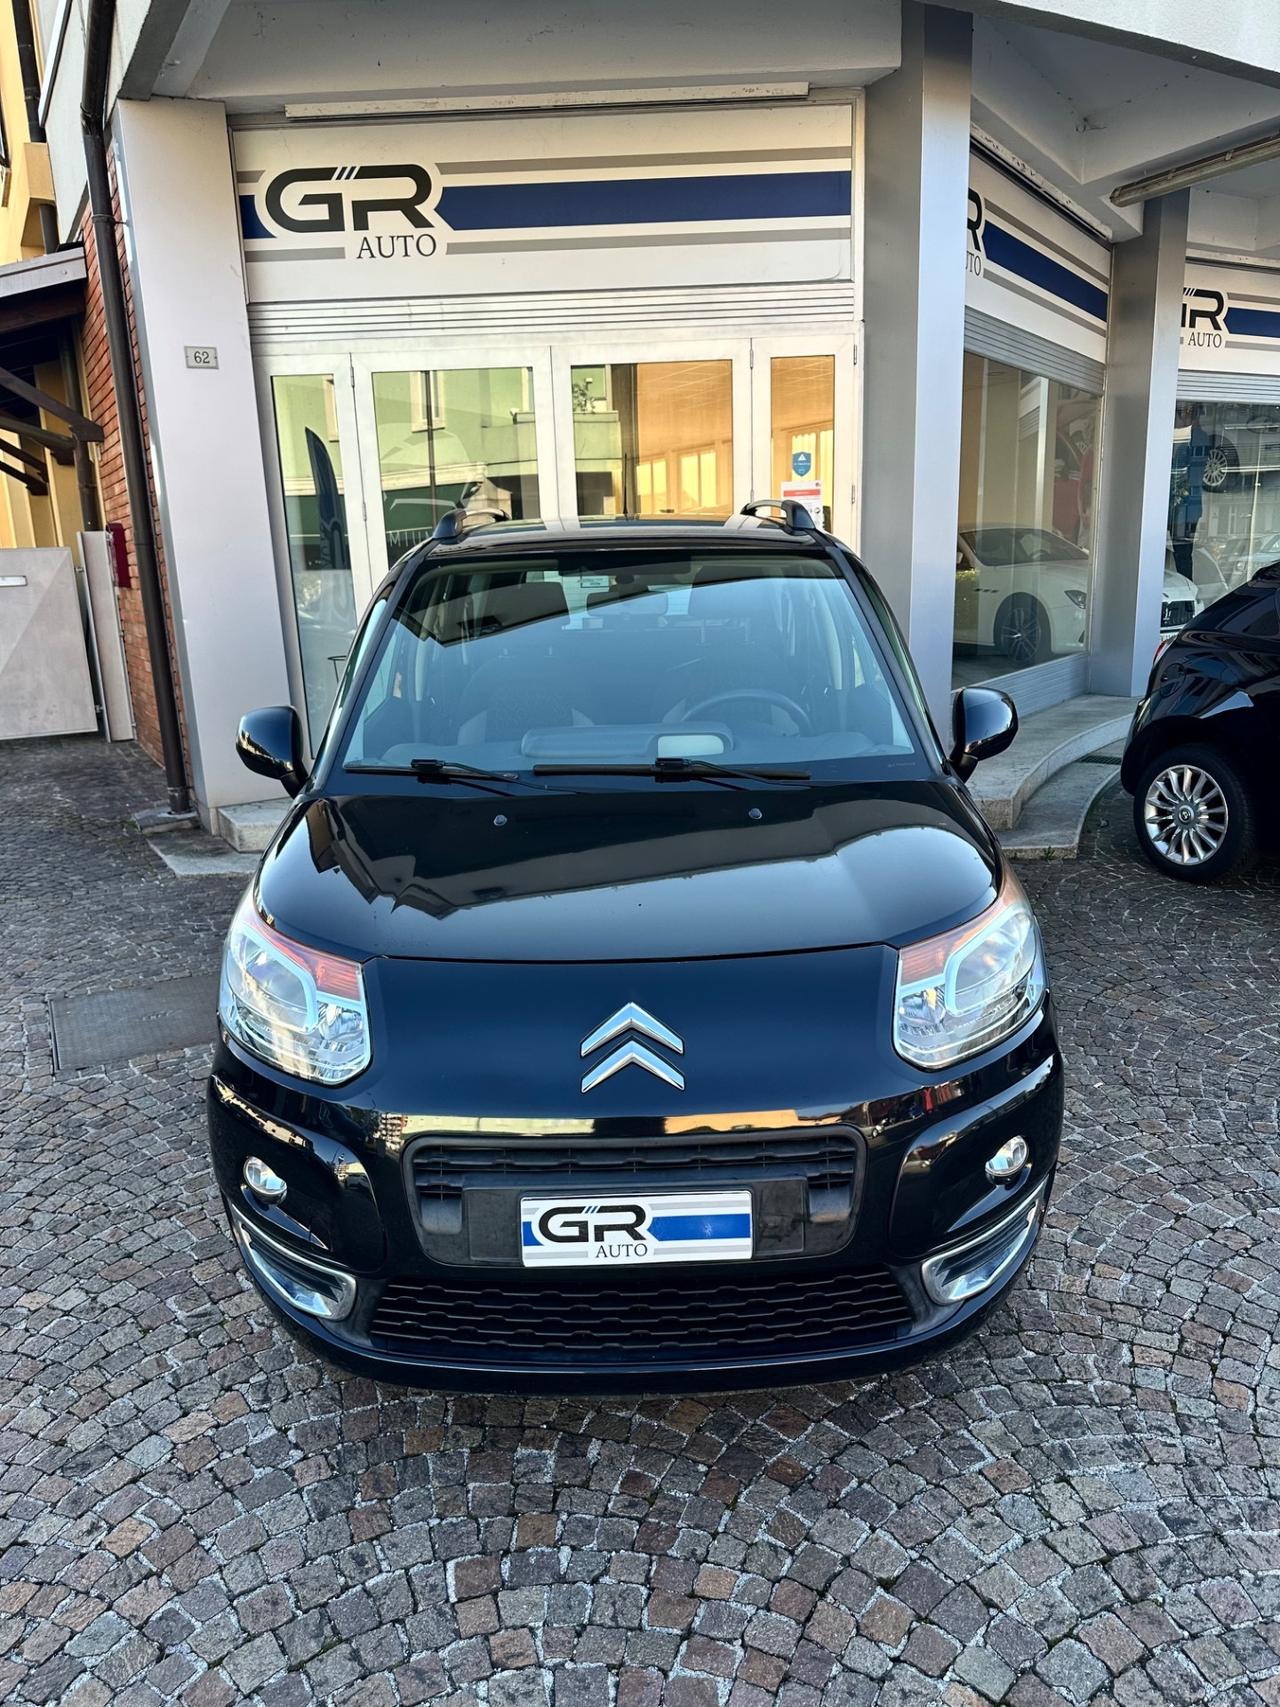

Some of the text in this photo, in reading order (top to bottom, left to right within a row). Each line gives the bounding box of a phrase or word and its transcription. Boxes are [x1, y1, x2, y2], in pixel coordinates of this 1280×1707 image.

[265, 164, 435, 233] GR
[356, 234, 437, 259] AUTO
[1187, 332, 1223, 348] AUTO
[193, 350, 211, 364] 62
[538, 1204, 647, 1243] GR
[595, 1243, 648, 1259] AUTO
